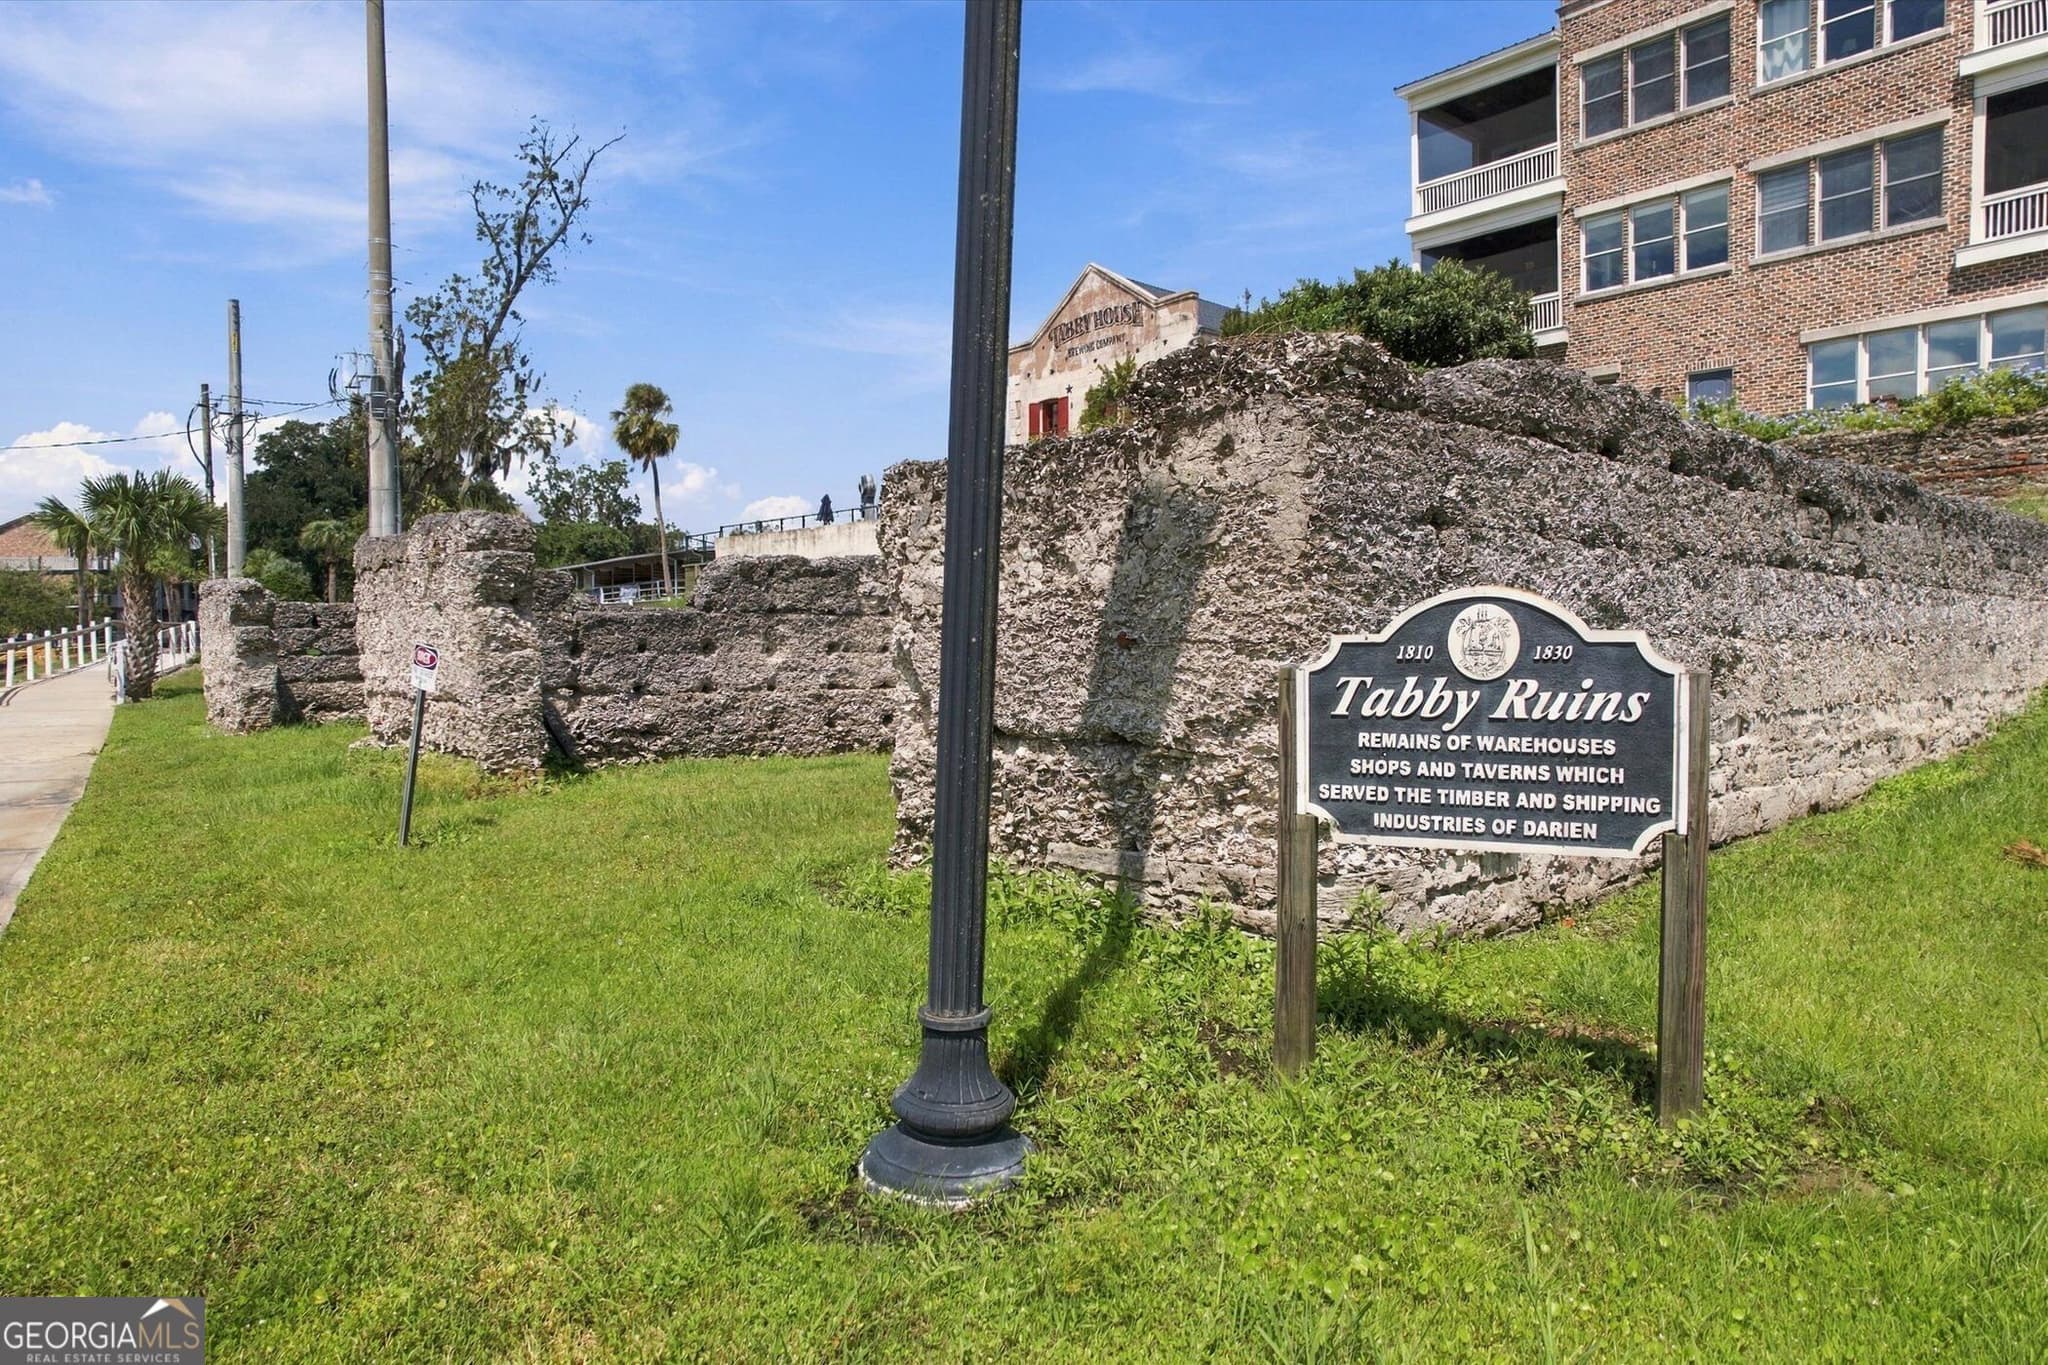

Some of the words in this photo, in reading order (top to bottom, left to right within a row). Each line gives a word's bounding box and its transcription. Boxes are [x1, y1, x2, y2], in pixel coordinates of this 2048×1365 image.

[1093, 300, 1144, 331] HOUSE
[1396, 644, 1434, 660] 1810
[1533, 644, 1573, 661] 1830
[1331, 675, 1481, 732] Tabby
[1489, 678, 1651, 723] Ruins
[1358, 732, 1441, 752] REMAINS
[1446, 734, 1472, 752] OF
[1476, 735, 1616, 756] WAREHOUSES
[1350, 758, 1412, 777] SHOPS
[1417, 760, 1456, 778] AND
[1461, 762, 1551, 782] TAVERNS
[1555, 765, 1625, 785] WHICH
[1319, 783, 1390, 803] SERVED
[1393, 786, 1432, 805] THE
[1436, 788, 1510, 809] TIMBER
[1516, 791, 1557, 811] AND
[1562, 794, 1662, 816] SHIPPING
[1373, 812, 1486, 834] INDUSTRIES
[1491, 818, 1517, 835] OF
[1523, 820, 1598, 840] DARIEN
